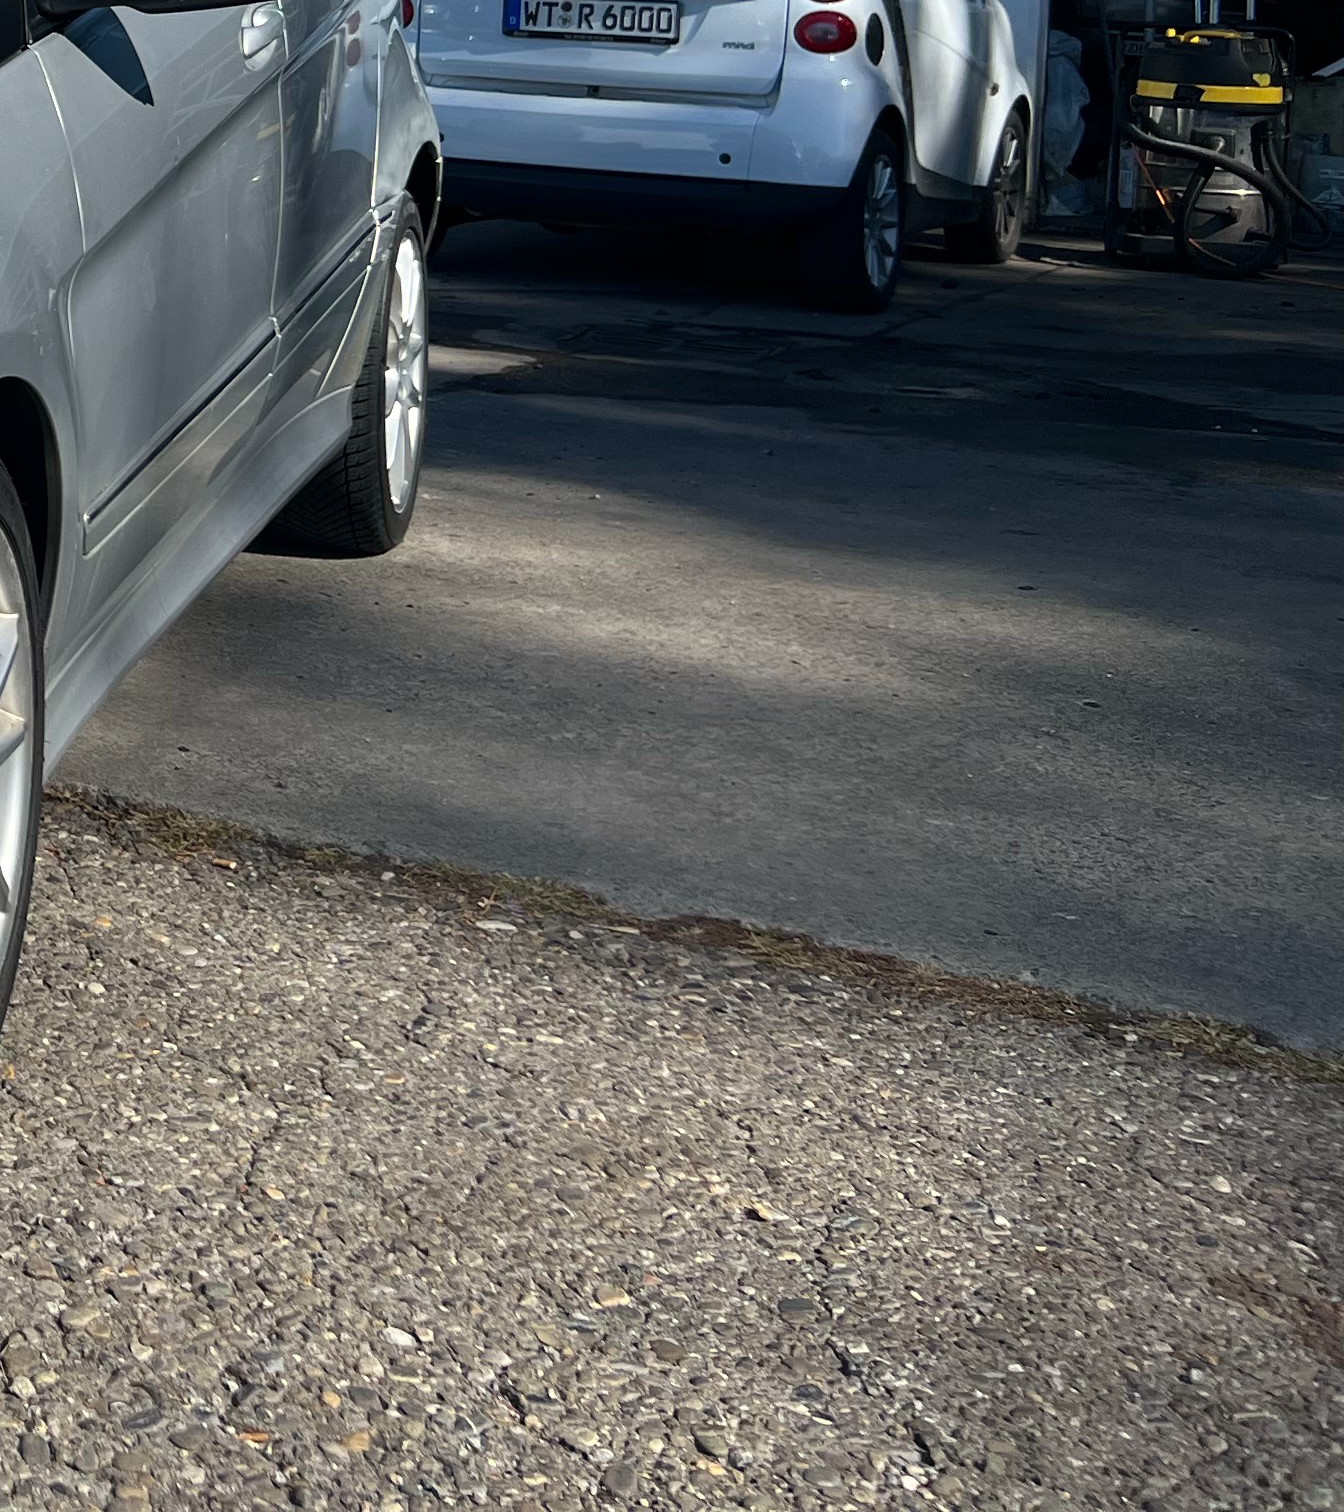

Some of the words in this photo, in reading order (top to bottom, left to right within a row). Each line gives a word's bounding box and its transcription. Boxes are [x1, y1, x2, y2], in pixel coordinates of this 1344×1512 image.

[523, 0, 559, 28] WT
[576, 3, 595, 30] R
[601, 4, 673, 34] 6000
